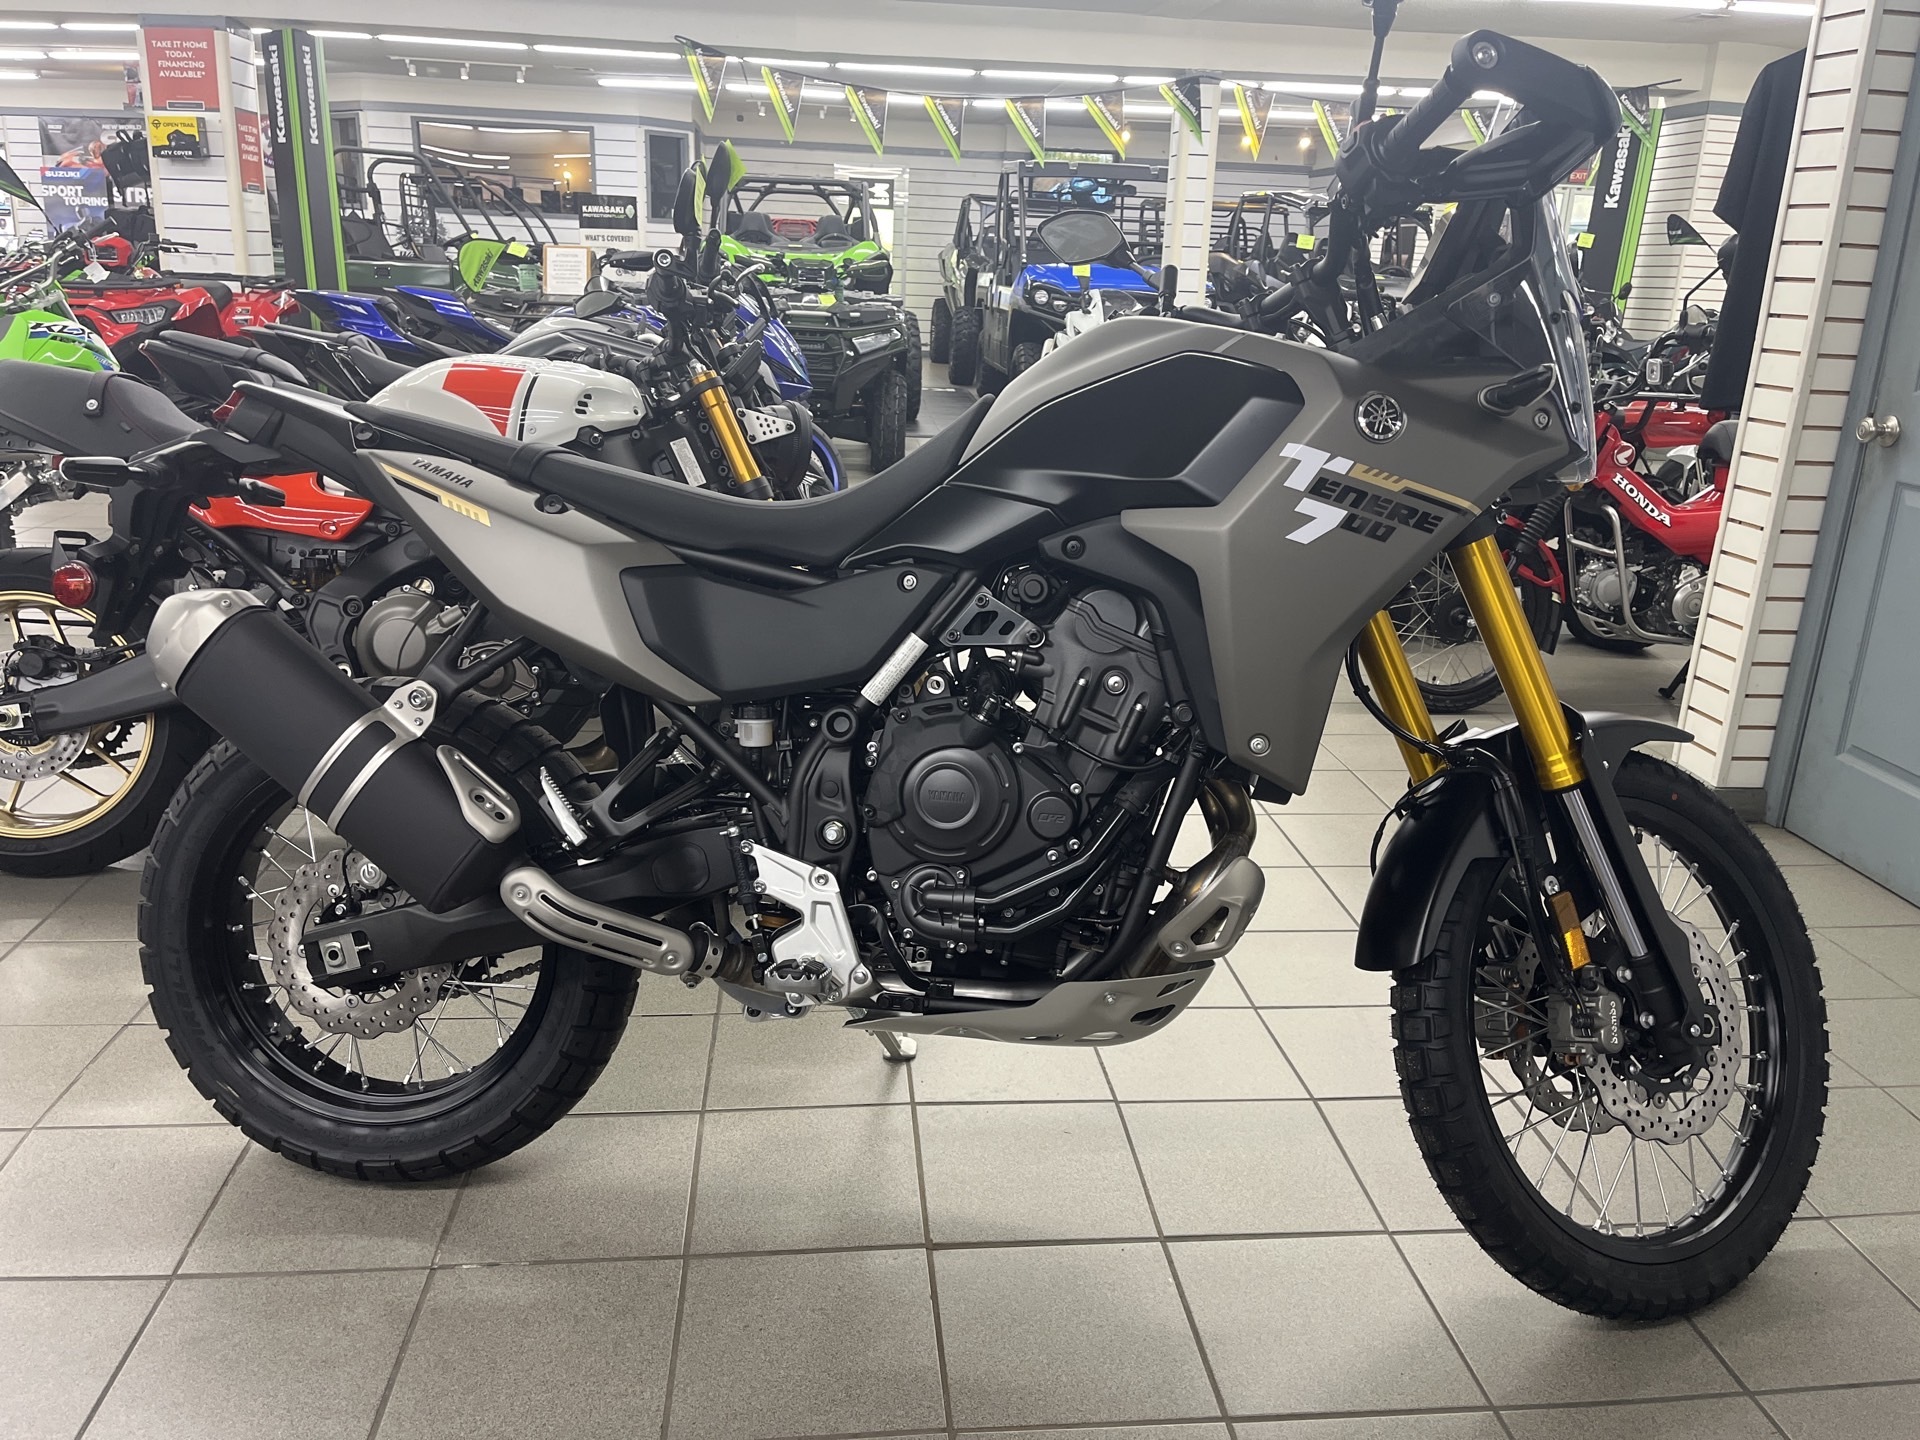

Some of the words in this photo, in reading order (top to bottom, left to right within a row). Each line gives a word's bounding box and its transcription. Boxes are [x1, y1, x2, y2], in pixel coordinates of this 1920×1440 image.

[151, 40, 172, 48] TAKE
[173, 40, 181, 48] IT
[182, 41, 208, 49] HOME
[165, 50, 196, 58] TODAY.
[157, 60, 205, 69] FINANCING
[695, 47, 715, 91] Kawasaki
[268, 44, 287, 144] Kawasaki
[302, 45, 319, 145] Kawasaki
[773, 72, 794, 113] Kawasaki
[1170, 84, 1198, 117] Kawasaki
[1619, 93, 1647, 125] Kawasaki
[857, 90, 882, 130] Kawasaki
[934, 98, 959, 137] Kawasaki
[1015, 101, 1041, 138] Kawasaki
[1094, 96, 1122, 131] Kawasaki
[1245, 90, 1262, 130] Kawasaki
[1323, 104, 1344, 142] Kawasaki
[45, 170, 81, 178] SUZUKI
[1570, 171, 1588, 181] EXIT
[1604, 125, 1632, 209] Kawasak
[41, 185, 84, 197] SPORT
[62, 196, 109, 206] TOURING
[582, 205, 625, 214] KAWASAKI
[412, 457, 475, 489] YAMAHA
[1611, 472, 1672, 528] HONDA
[928, 789, 967, 804] YAMAHA
[1037, 812, 1067, 824] CP2
[1609, 1000, 1619, 1045] brembo
